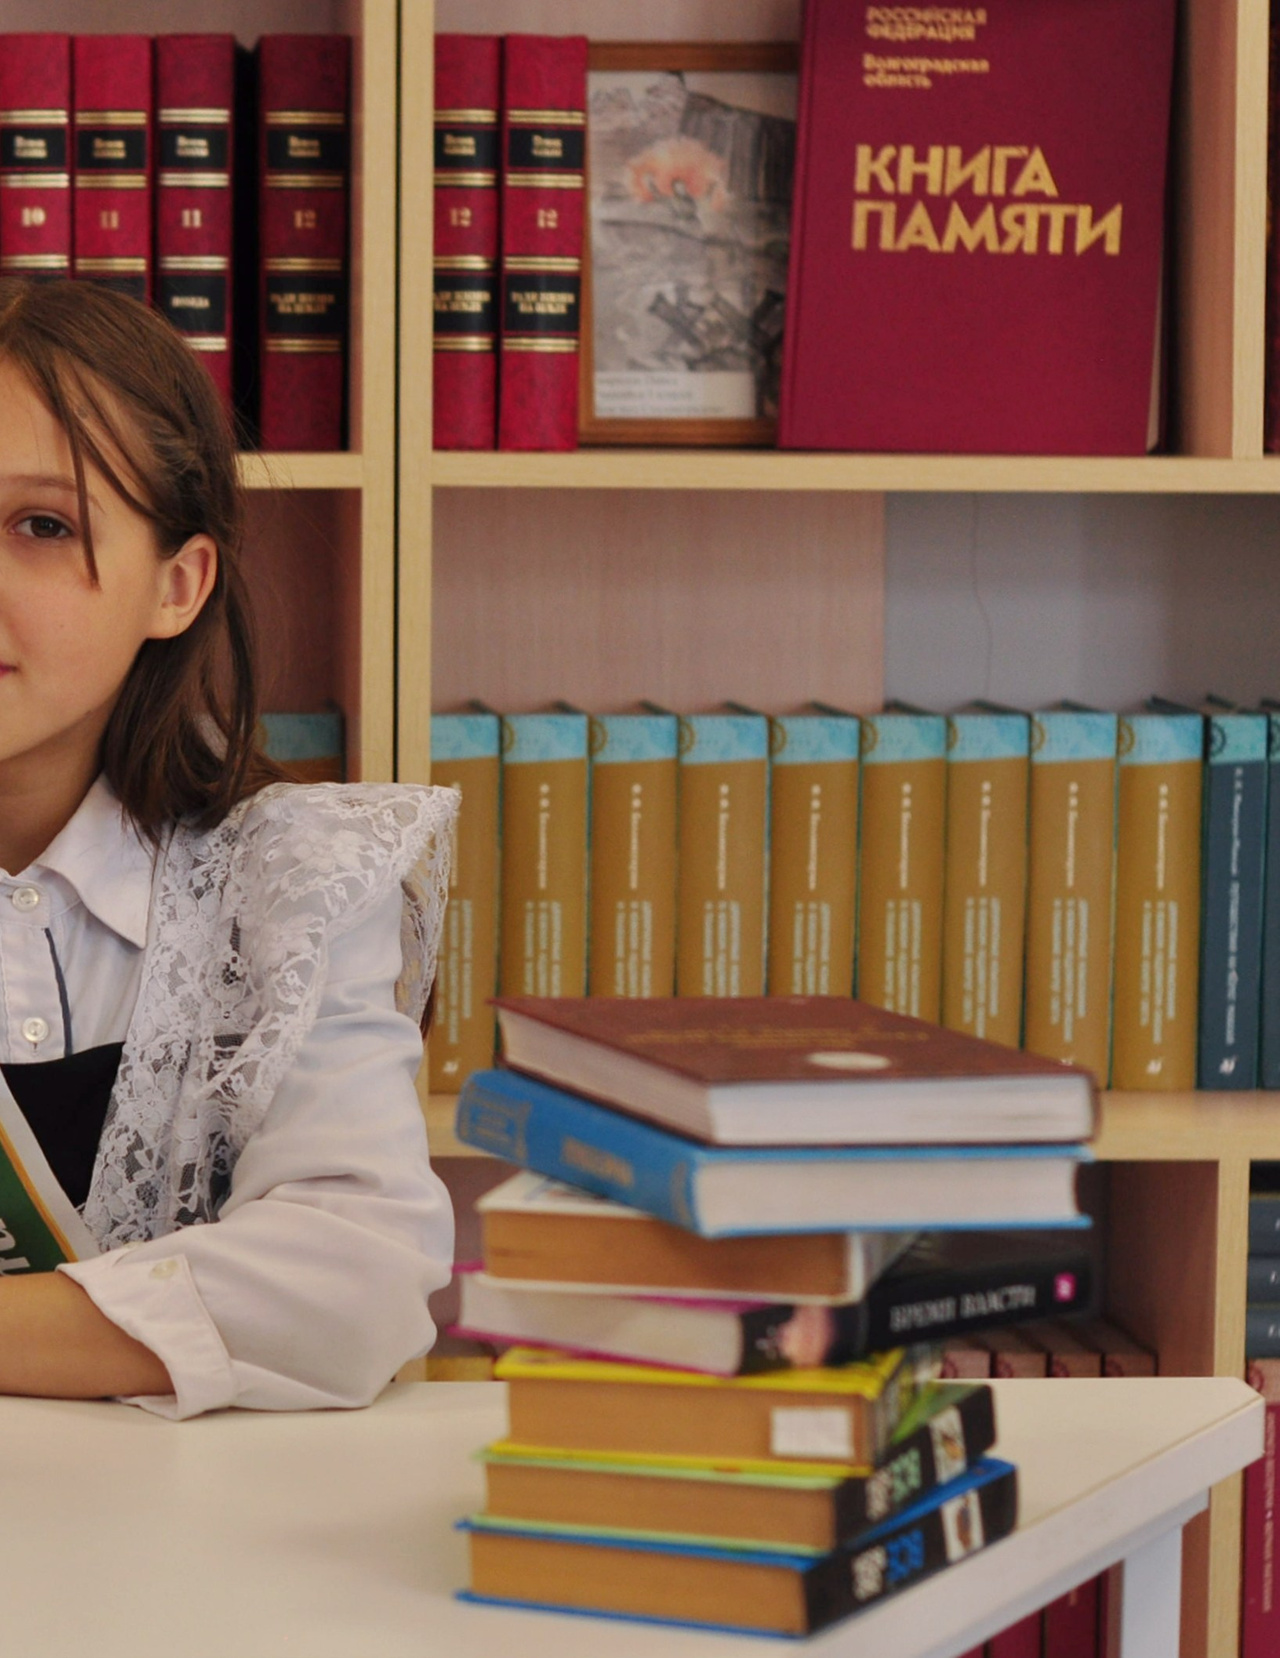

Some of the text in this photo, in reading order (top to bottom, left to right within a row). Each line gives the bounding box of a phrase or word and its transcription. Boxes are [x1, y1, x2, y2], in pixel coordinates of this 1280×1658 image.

[867, 7, 987, 24] РОССИЙСКАЯ
[867, 23, 975, 41] ФЕДЕРАЦИЯ
[863, 53, 989, 73] Волгоградская
[863, 73, 931, 88] область
[854, 145, 1058, 197] КНИГА
[22, 208, 46, 226] 10
[182, 209, 201, 228] 11
[852, 200, 1122, 255] ПАМЯТИ
[890, 1284, 1037, 1332] ВРЕМЯ ВЛАСТИ
